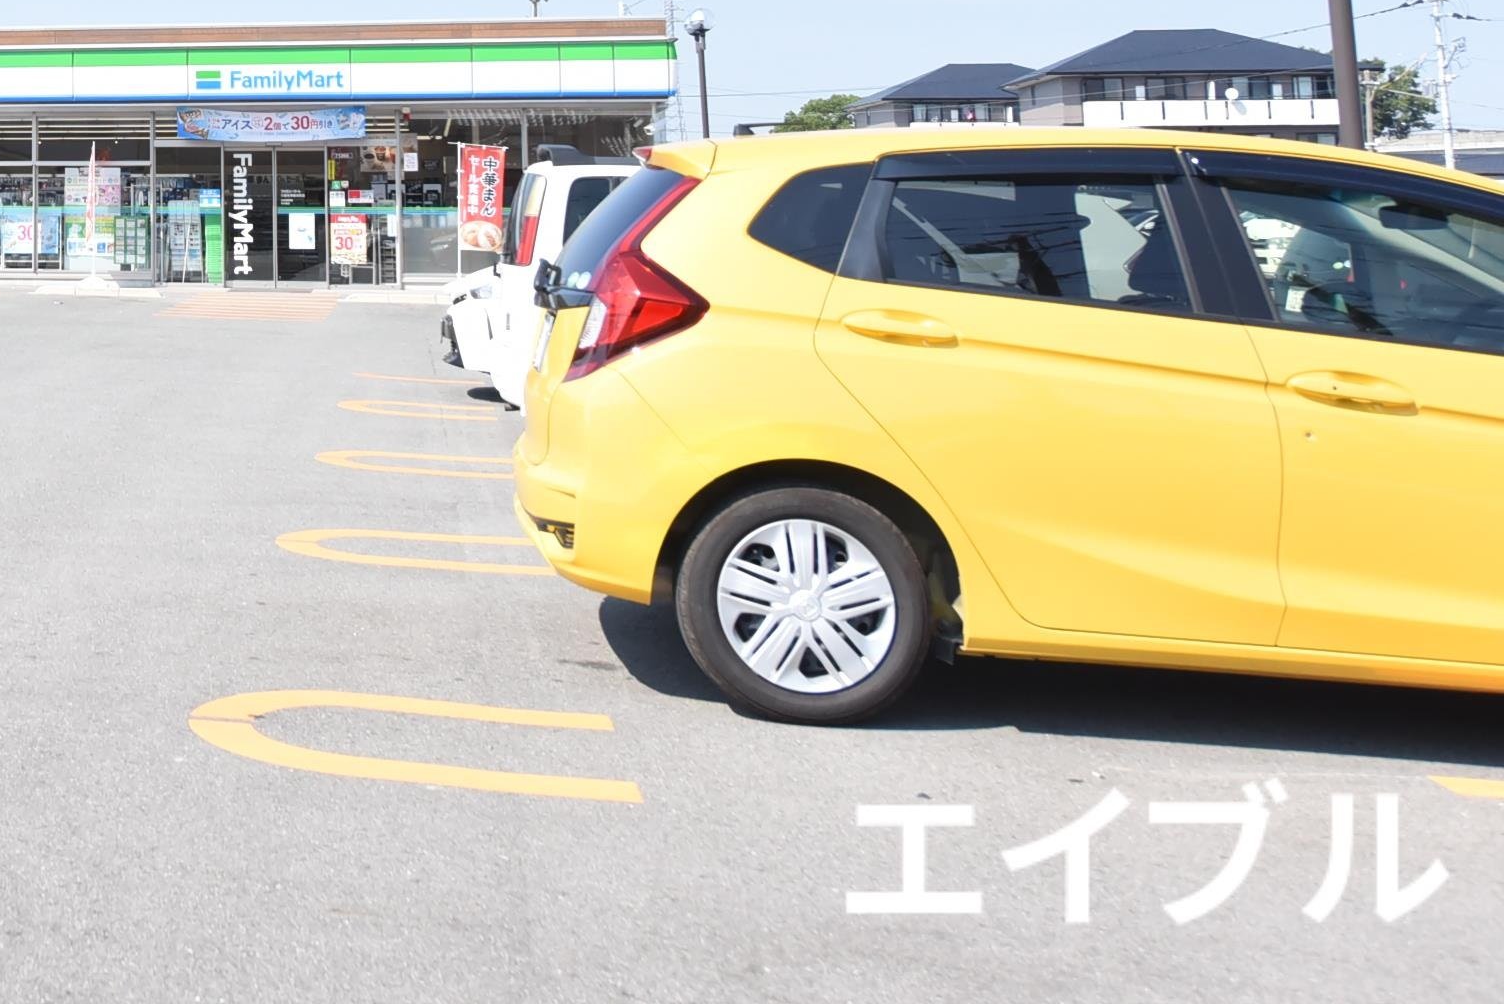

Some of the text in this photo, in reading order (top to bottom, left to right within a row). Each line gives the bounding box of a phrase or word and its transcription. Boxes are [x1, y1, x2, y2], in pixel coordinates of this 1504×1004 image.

[230, 70, 344, 91] FamilyMart
[222, 118, 253, 130] アイス
[483, 156, 498, 216] 中華まん
[228, 153, 254, 275] FamilyMart
[335, 236, 353, 250] 30
